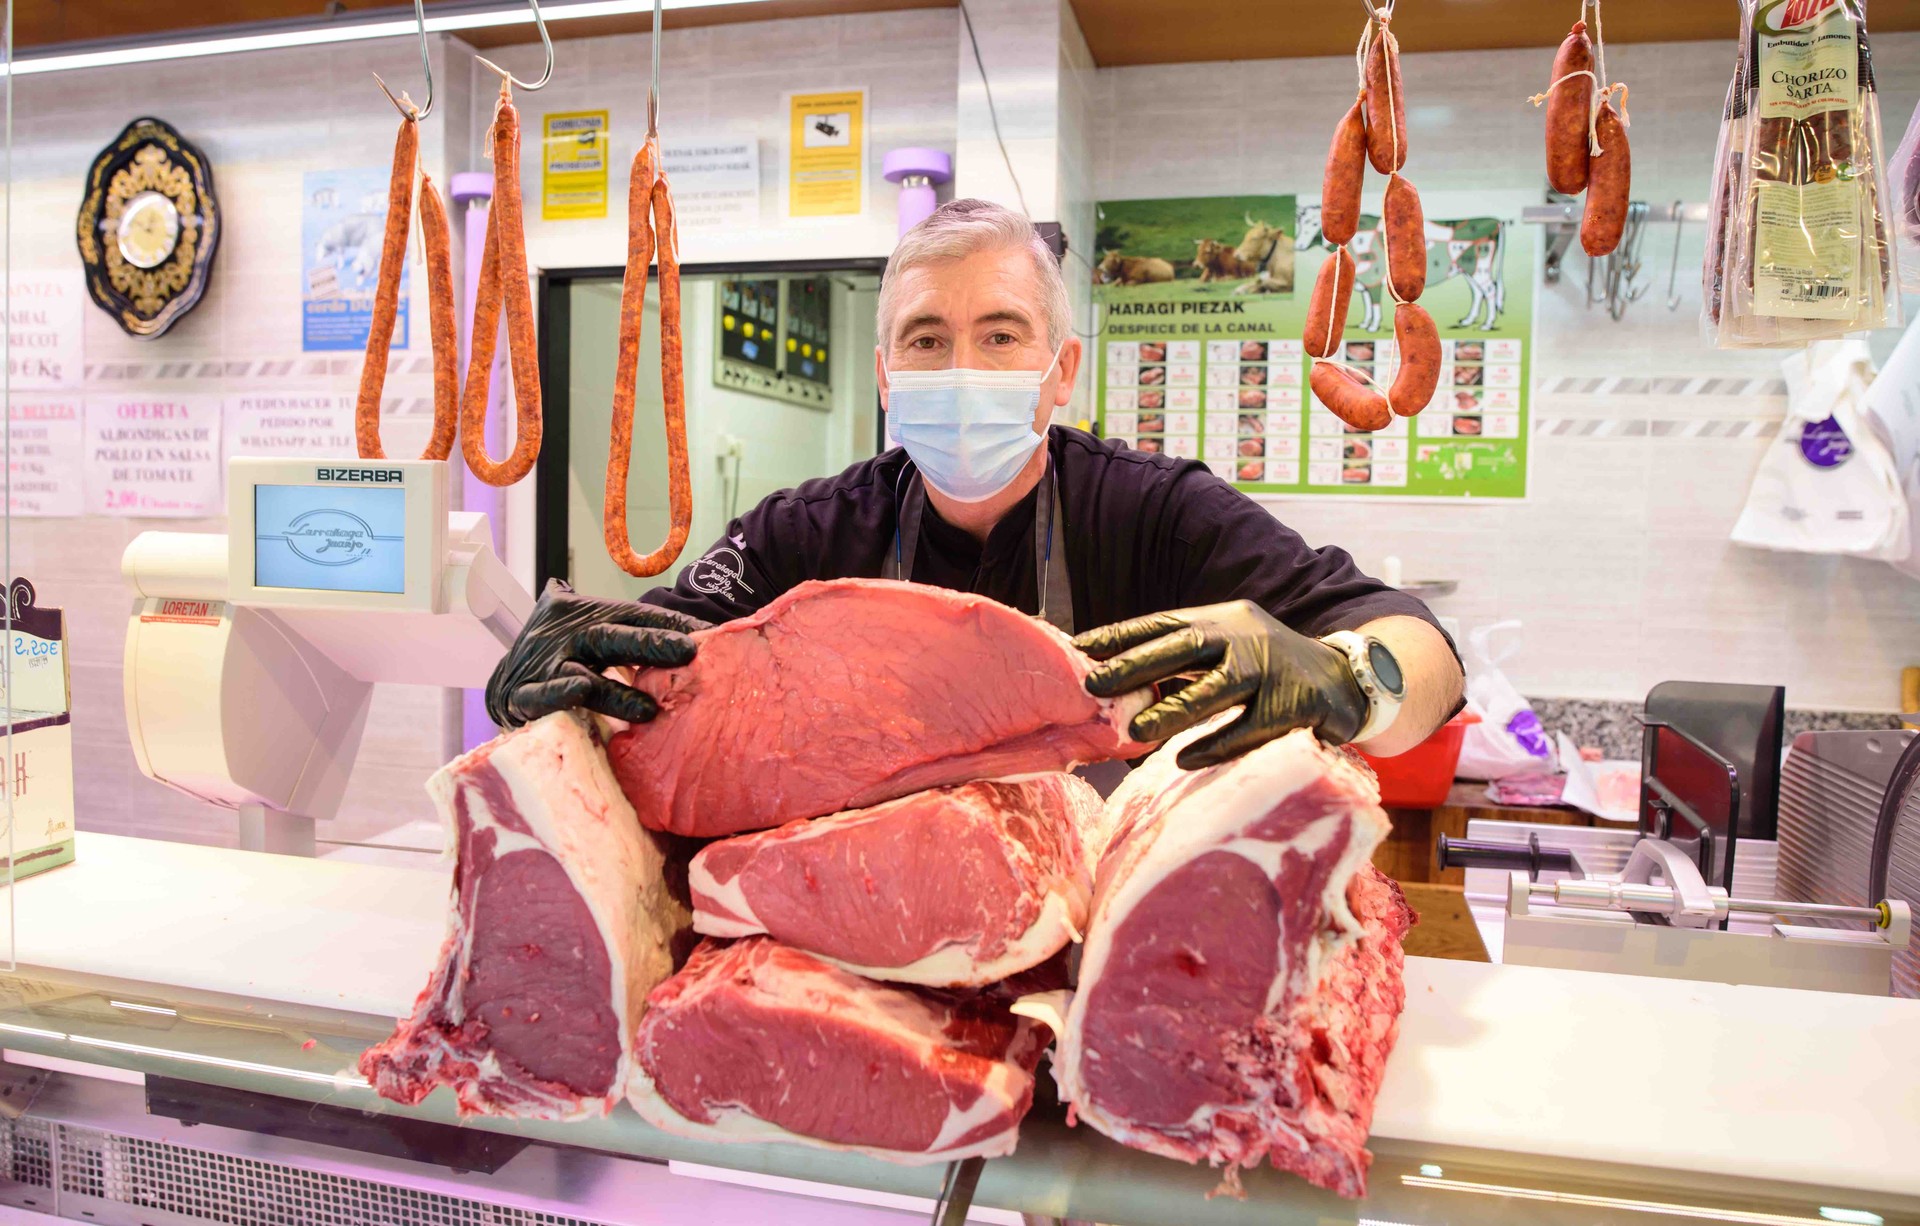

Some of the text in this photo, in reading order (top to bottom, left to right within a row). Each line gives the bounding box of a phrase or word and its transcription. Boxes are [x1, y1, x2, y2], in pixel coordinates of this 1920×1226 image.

[1767, 39, 1809, 48] Embutidos
[1817, 34, 1851, 42] Jamones
[1771, 67, 1847, 87] CHORIZO
[1786, 82, 1833, 100] SARTA
[1109, 301, 1245, 316] HARAGI PIEZAK
[1109, 322, 1276, 334] DESPIECE DE LA CANAL
[116, 401, 189, 419] OFERTA
[94, 447, 143, 462] POLLO
[135, 467, 194, 482] TOMATE
[316, 469, 403, 482] BIZERBA
[161, 600, 209, 617] LORETAN
